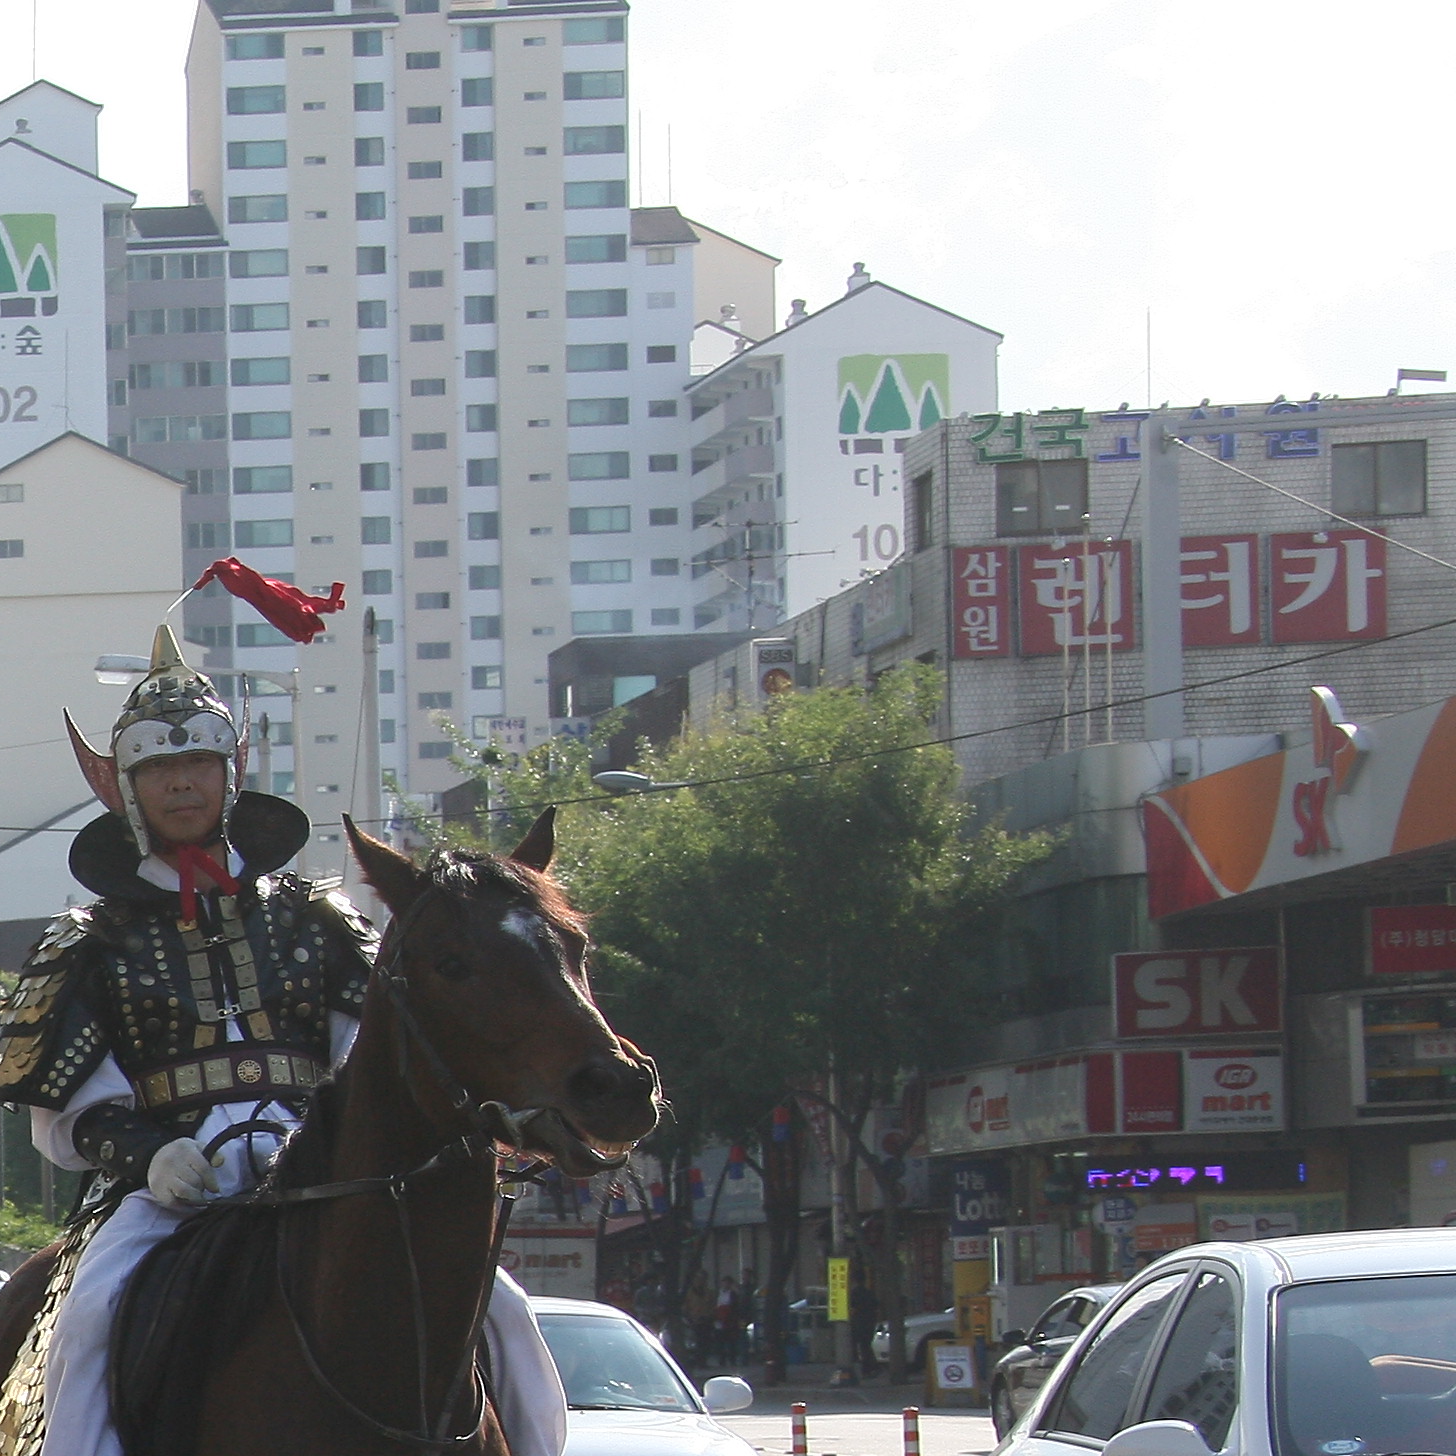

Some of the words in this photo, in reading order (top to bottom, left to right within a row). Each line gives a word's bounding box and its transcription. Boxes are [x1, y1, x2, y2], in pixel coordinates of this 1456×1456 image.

[852, 523, 899, 562] 10
[960, 551, 1003, 652] 삼원
[1030, 538, 1384, 647] 렌터카
[1293, 776, 1332, 858] SK
[1134, 956, 1258, 1030] SK
[1200, 1091, 1273, 1112] mart
